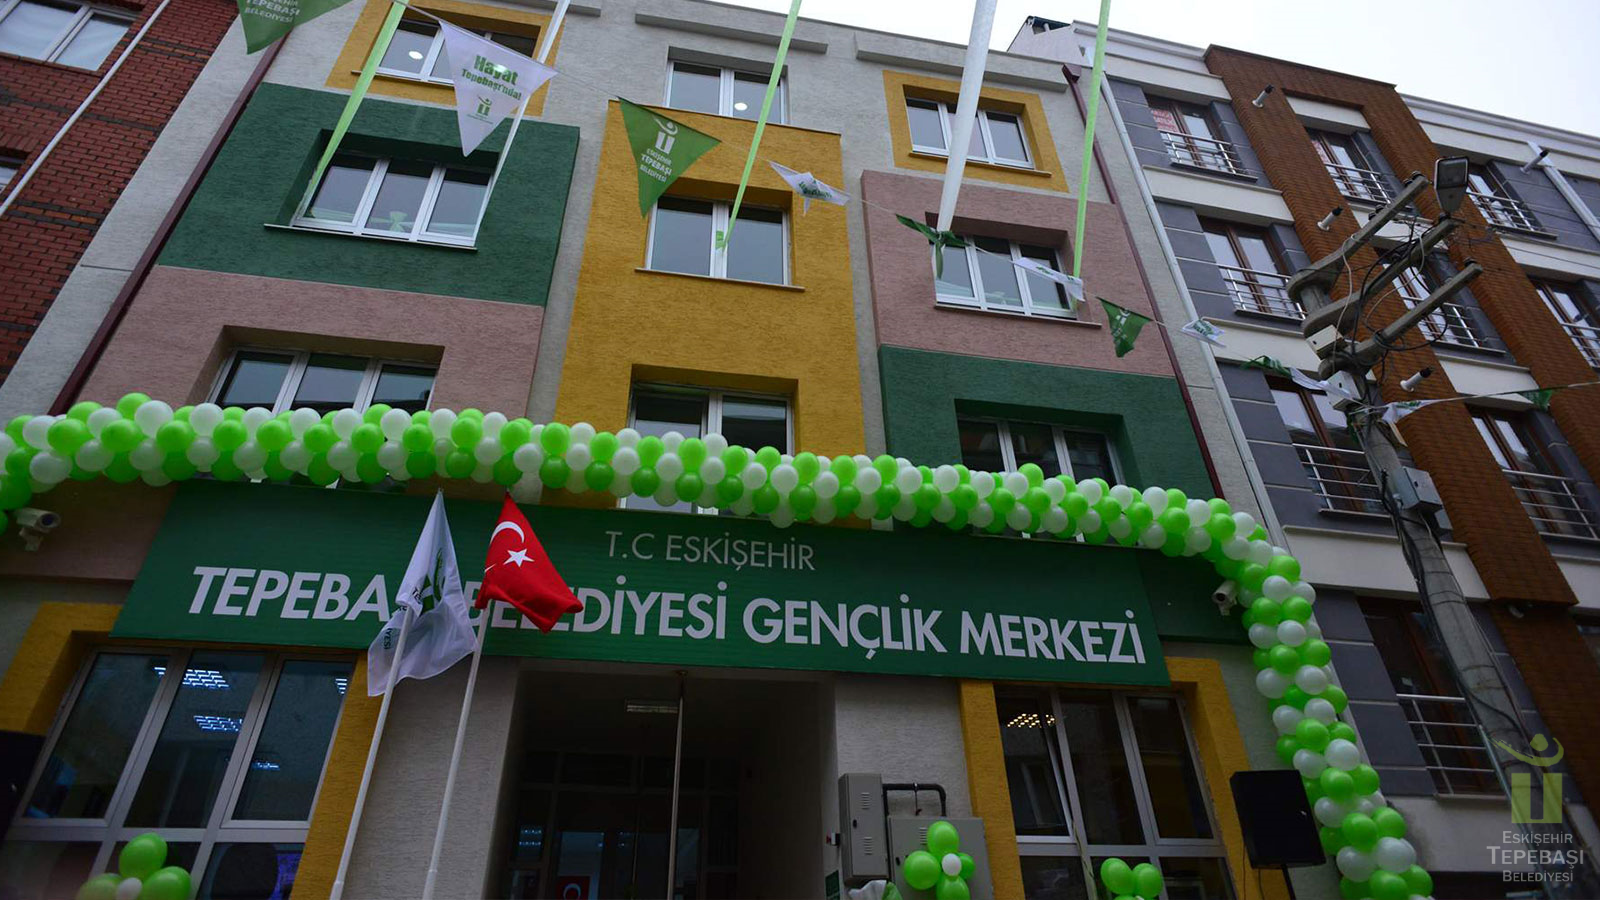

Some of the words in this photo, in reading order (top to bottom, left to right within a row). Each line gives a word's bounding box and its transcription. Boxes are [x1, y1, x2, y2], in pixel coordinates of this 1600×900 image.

[474, 55, 518, 85] Hayat
[605, 530, 655, 560] T.C
[665, 531, 816, 571] ESKİŞEHİR
[188, 566, 391, 622] TEPEBA
[742, 593, 949, 660] GENÇLİK
[959, 609, 1147, 664] MERKEZİ
